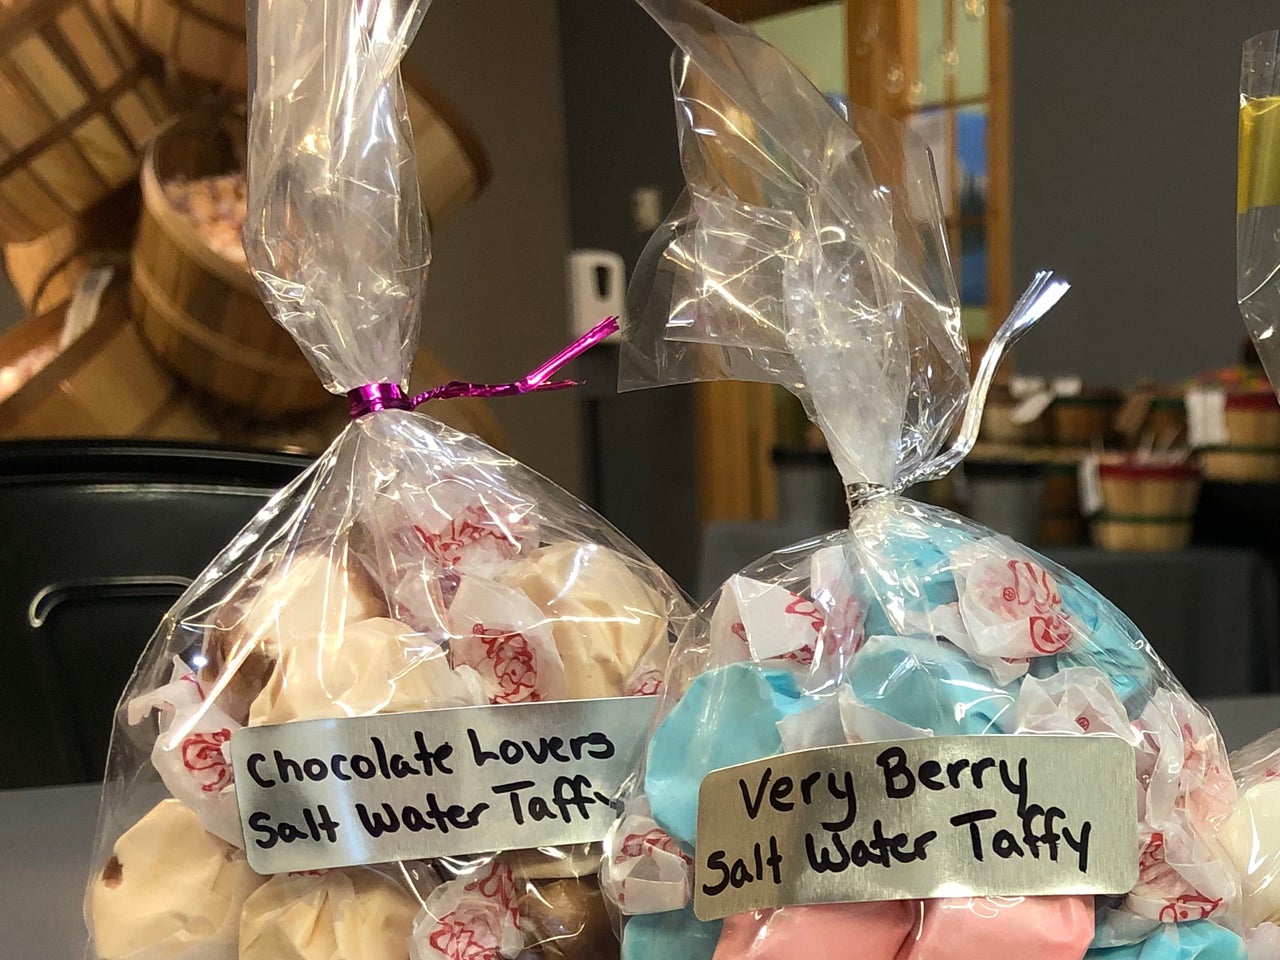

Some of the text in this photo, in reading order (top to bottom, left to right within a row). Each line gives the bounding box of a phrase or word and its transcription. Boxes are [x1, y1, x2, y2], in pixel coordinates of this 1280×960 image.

[247, 731, 453, 788] Chocolate
[467, 728, 615, 766] Lovers
[740, 746, 1027, 831] Very Berry
[248, 804, 340, 849] Salt
[356, 793, 490, 838] Water
[702, 803, 1092, 896] Salt Water Taffy
